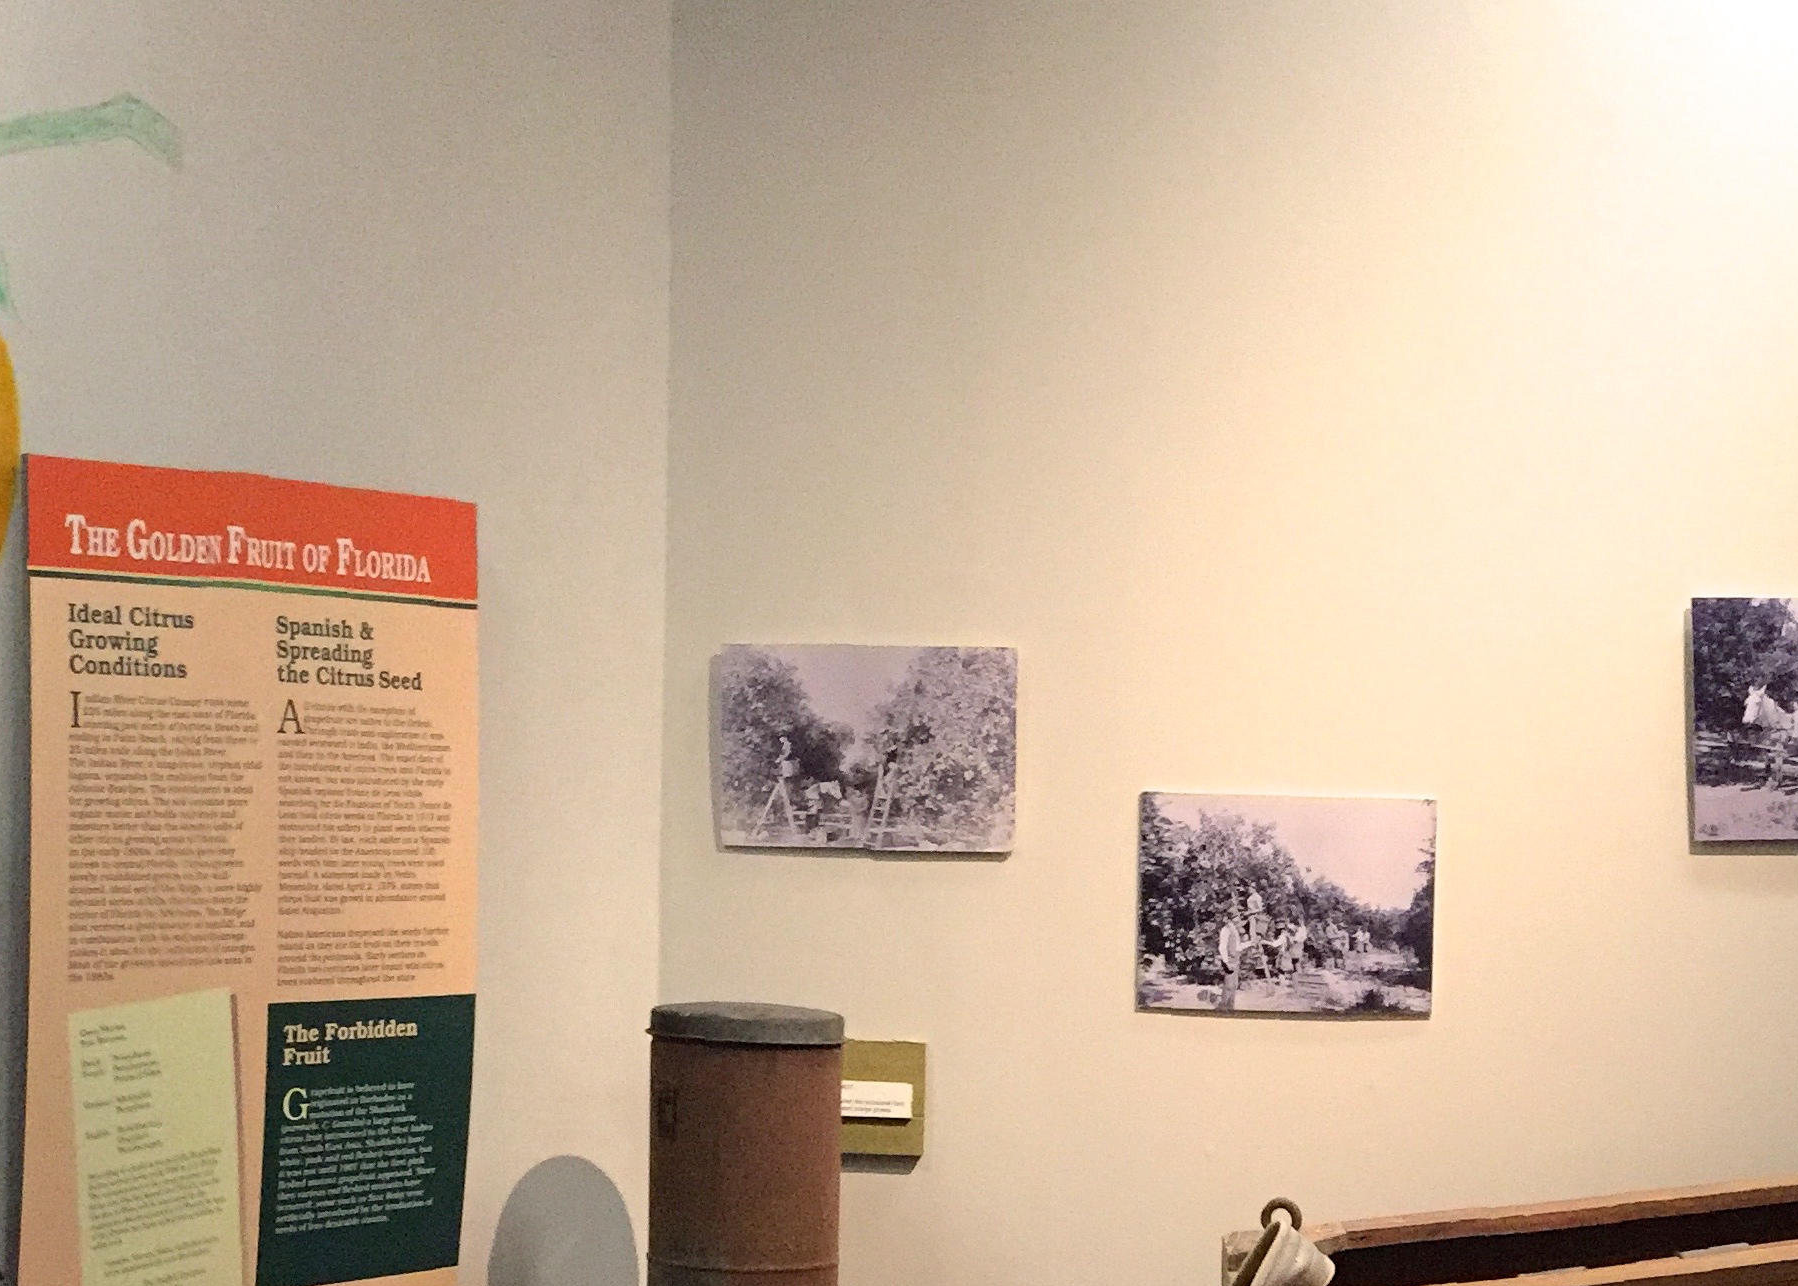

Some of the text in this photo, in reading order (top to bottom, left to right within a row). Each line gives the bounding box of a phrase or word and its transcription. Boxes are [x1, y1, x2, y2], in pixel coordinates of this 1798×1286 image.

[65, 513, 431, 583] THE GOLDEN FRUIT OF FLORIDA
[68, 603, 194, 629] Ideal Citrus
[276, 616, 374, 641] Spanish &
[68, 629, 159, 657] Growing
[276, 640, 374, 669] Spreading
[69, 655, 187, 679] Conditions
[278, 665, 422, 691] the Citrus Seed
[283, 1020, 418, 1043] The Forbidden
[282, 1047, 330, 1067] Fruit
